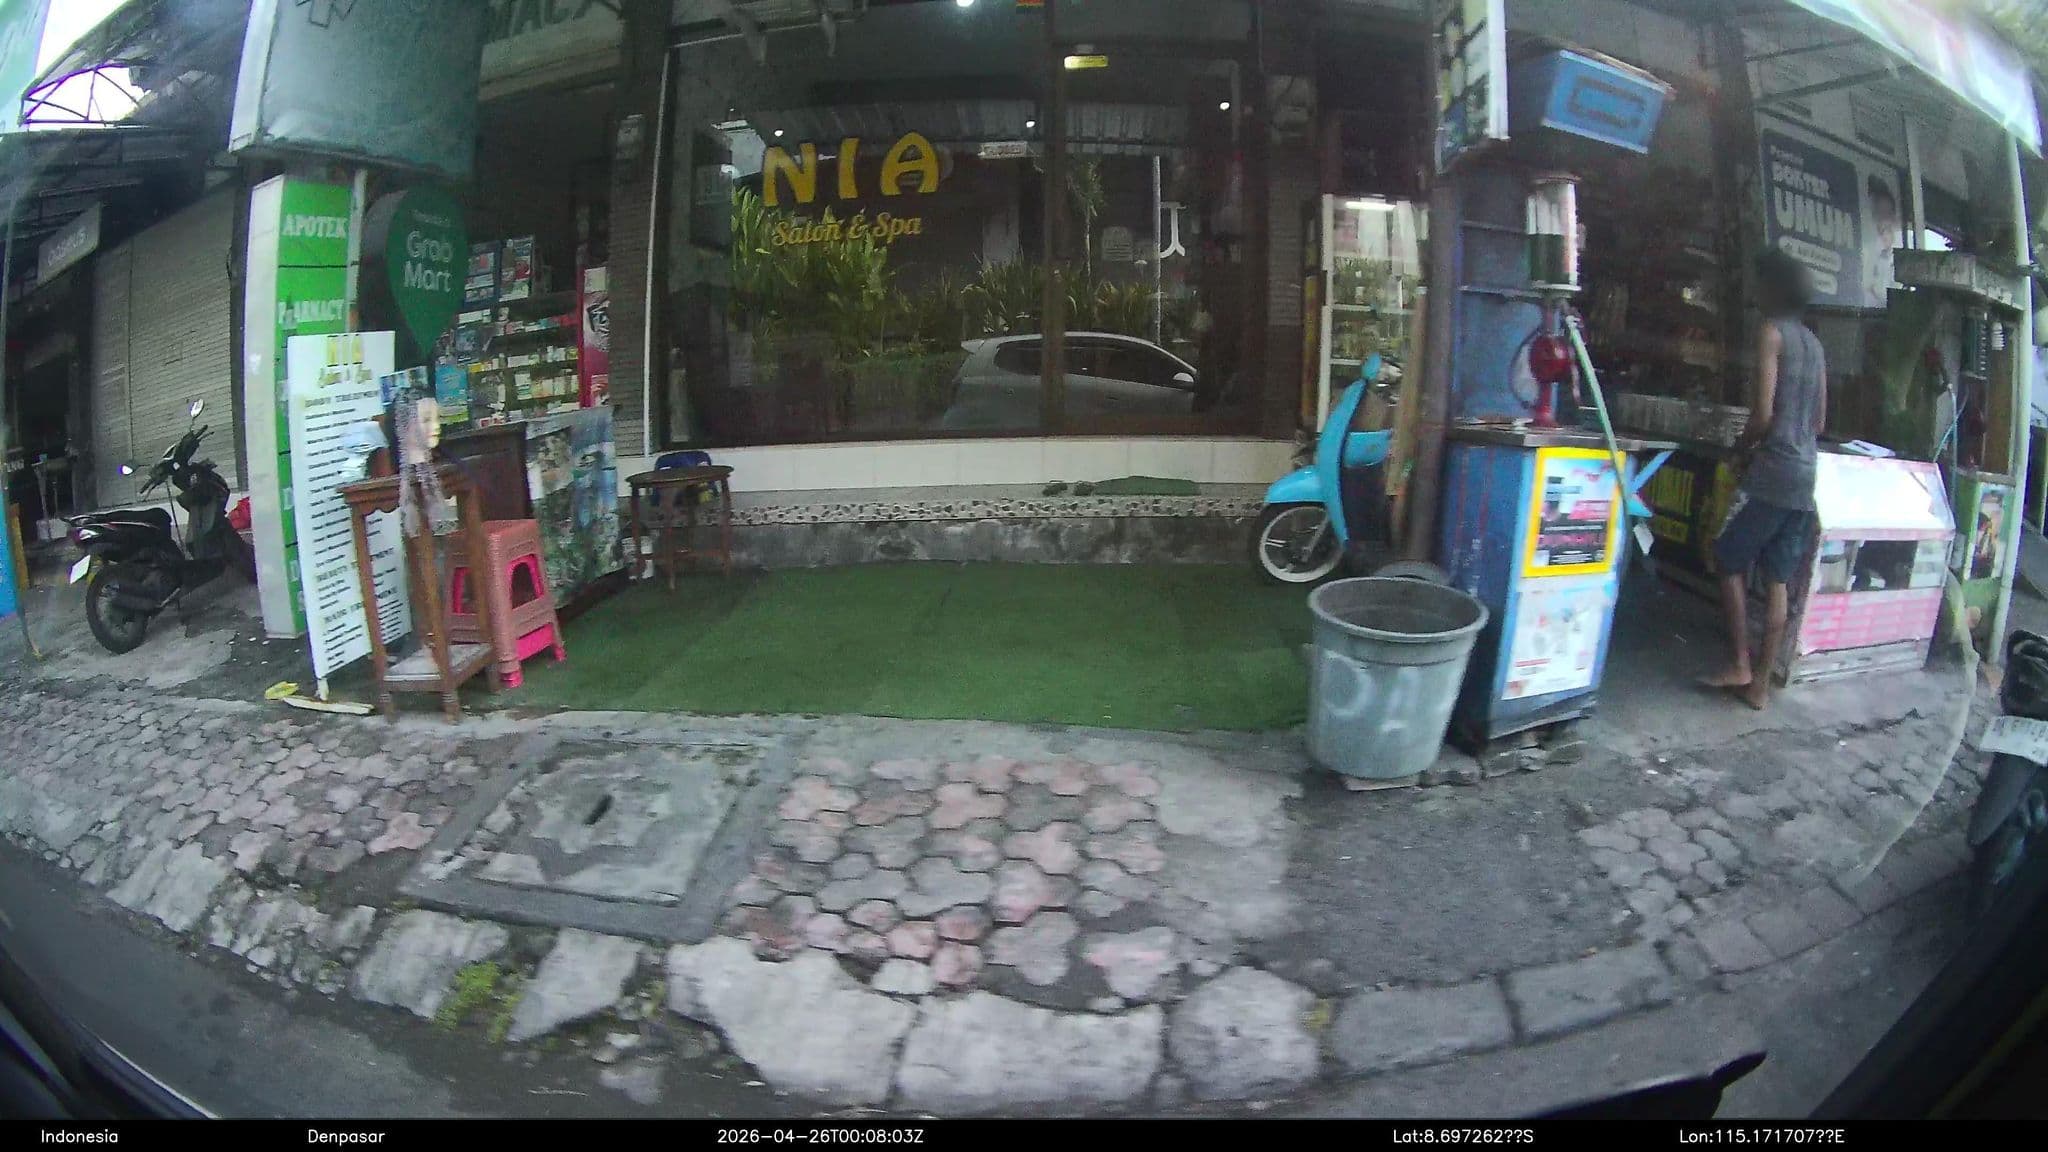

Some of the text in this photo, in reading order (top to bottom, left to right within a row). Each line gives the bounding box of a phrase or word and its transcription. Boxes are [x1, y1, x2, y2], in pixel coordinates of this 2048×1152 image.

[762, 132, 939, 207] NIA
[282, 213, 348, 238] APOTEK
[773, 211, 922, 246] Salon & Spa
[1774, 186, 1854, 249] UMUM
[407, 230, 454, 263] Grab
[404, 261, 452, 293] Mart
